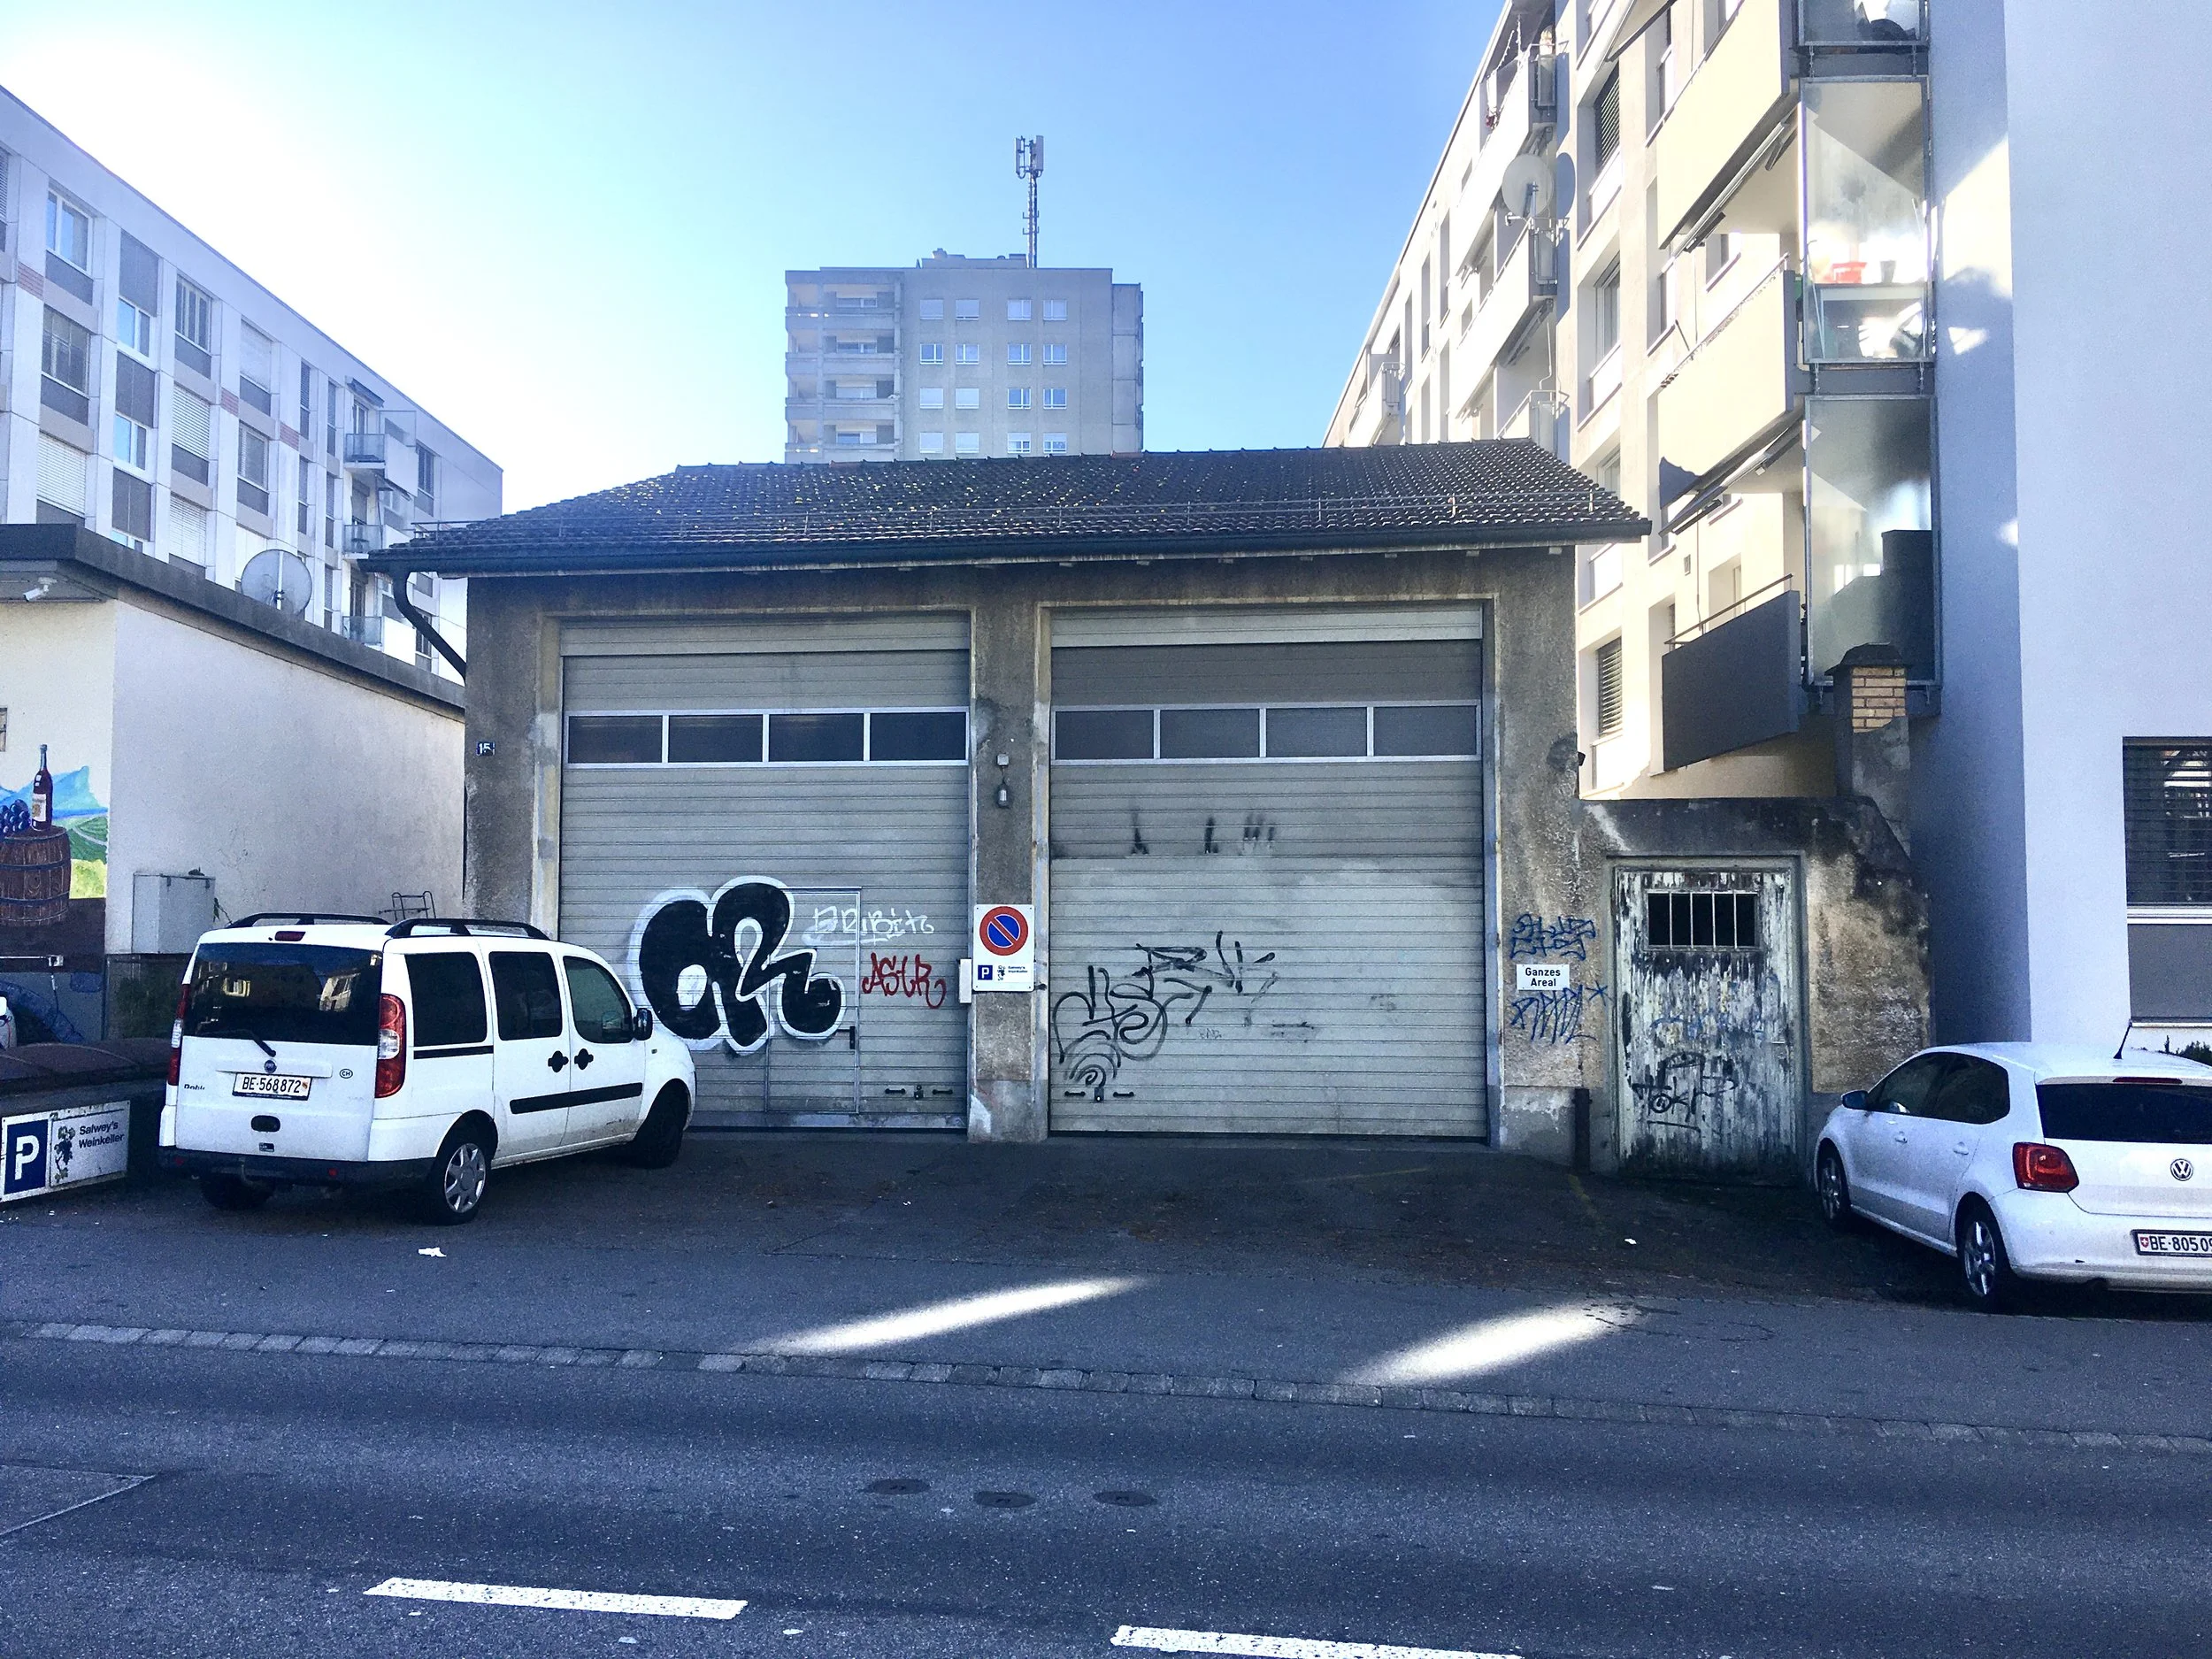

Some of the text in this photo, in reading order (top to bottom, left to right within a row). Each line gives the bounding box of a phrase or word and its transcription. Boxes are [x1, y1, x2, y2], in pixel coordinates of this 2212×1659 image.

[981, 967, 990, 979] P
[1525, 967, 1561, 977] Ganzes
[1531, 978, 1556, 987] Areal
[80, 1121, 119, 1135] Salwey's
[79, 1133, 125, 1149] Weinkeller
[15, 1134, 40, 1180] P
